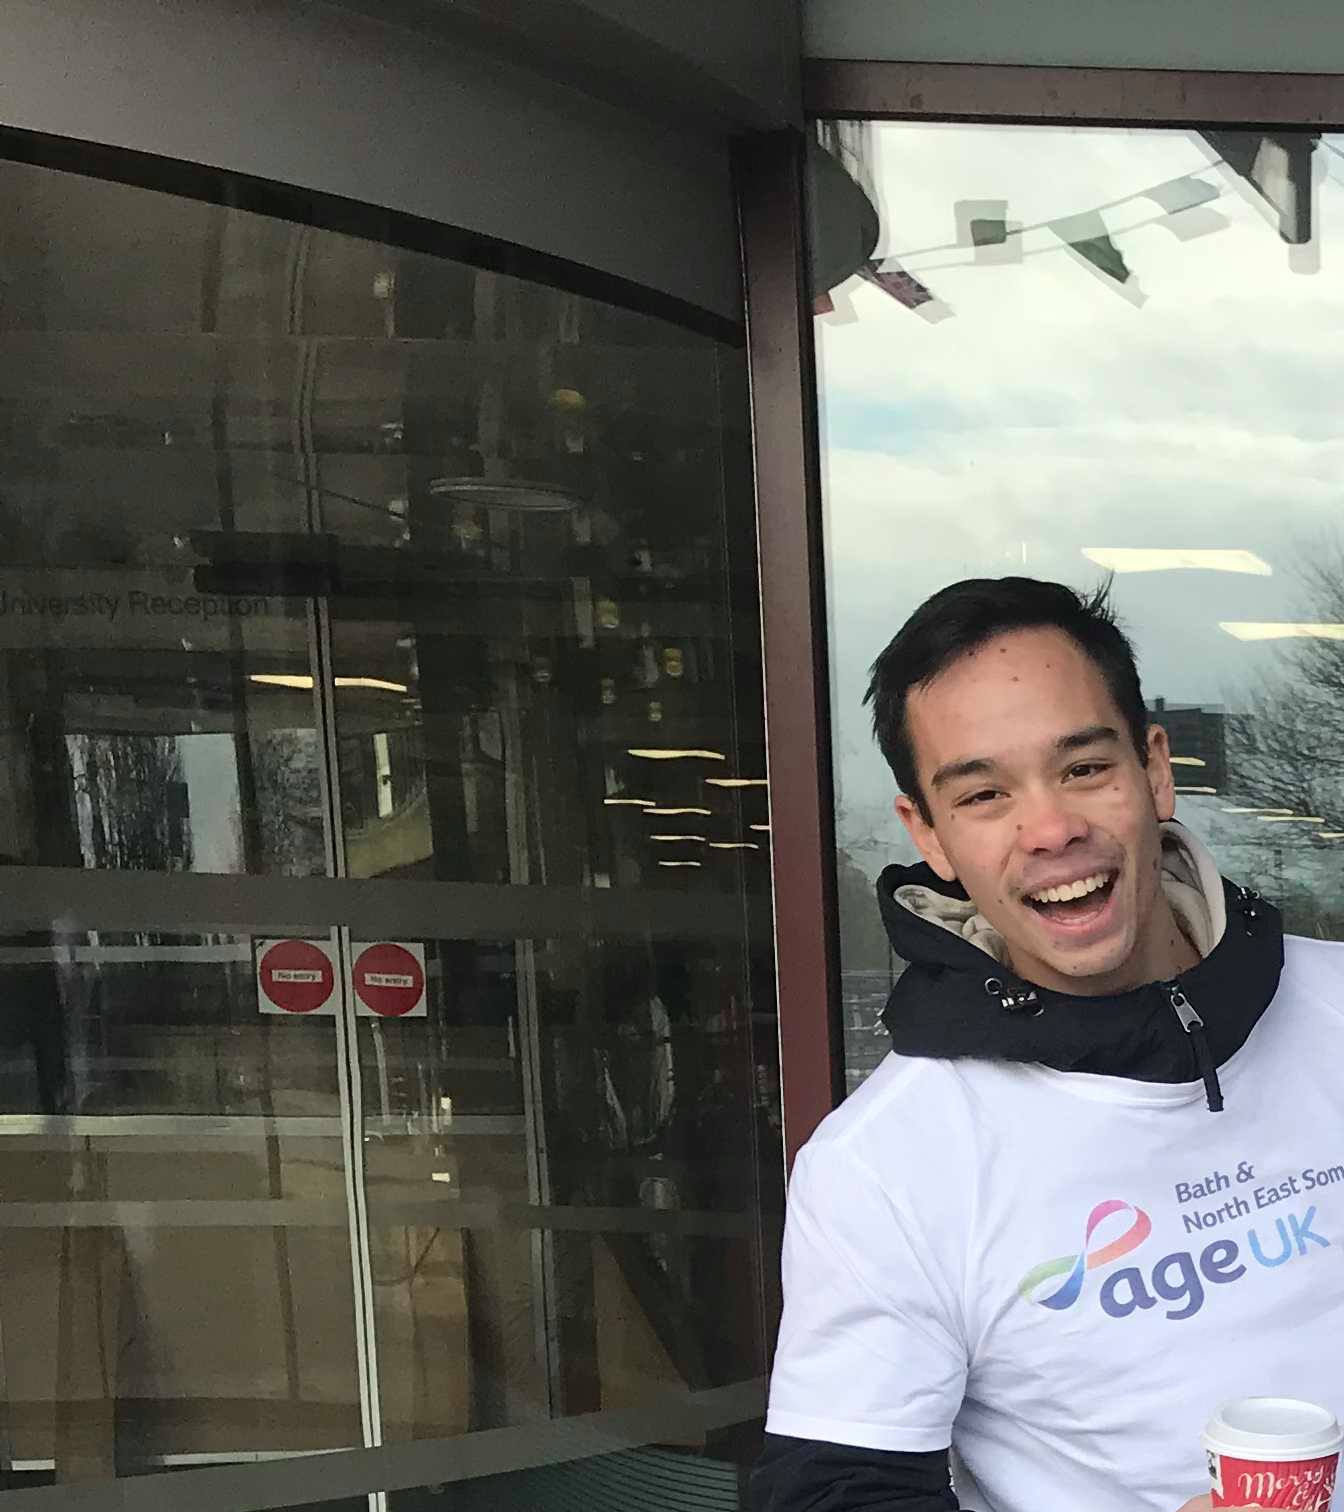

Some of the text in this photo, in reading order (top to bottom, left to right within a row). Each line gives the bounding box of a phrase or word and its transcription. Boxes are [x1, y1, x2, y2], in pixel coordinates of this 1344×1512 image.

[129, 590, 270, 621] Reception
[1174, 1160, 1256, 1204] Bath &
[1181, 1196, 1250, 1234] North
[1253, 1175, 1301, 1210] East
[1099, 1204, 1330, 1321] age UK
[1237, 1464, 1325, 1500] Merry
